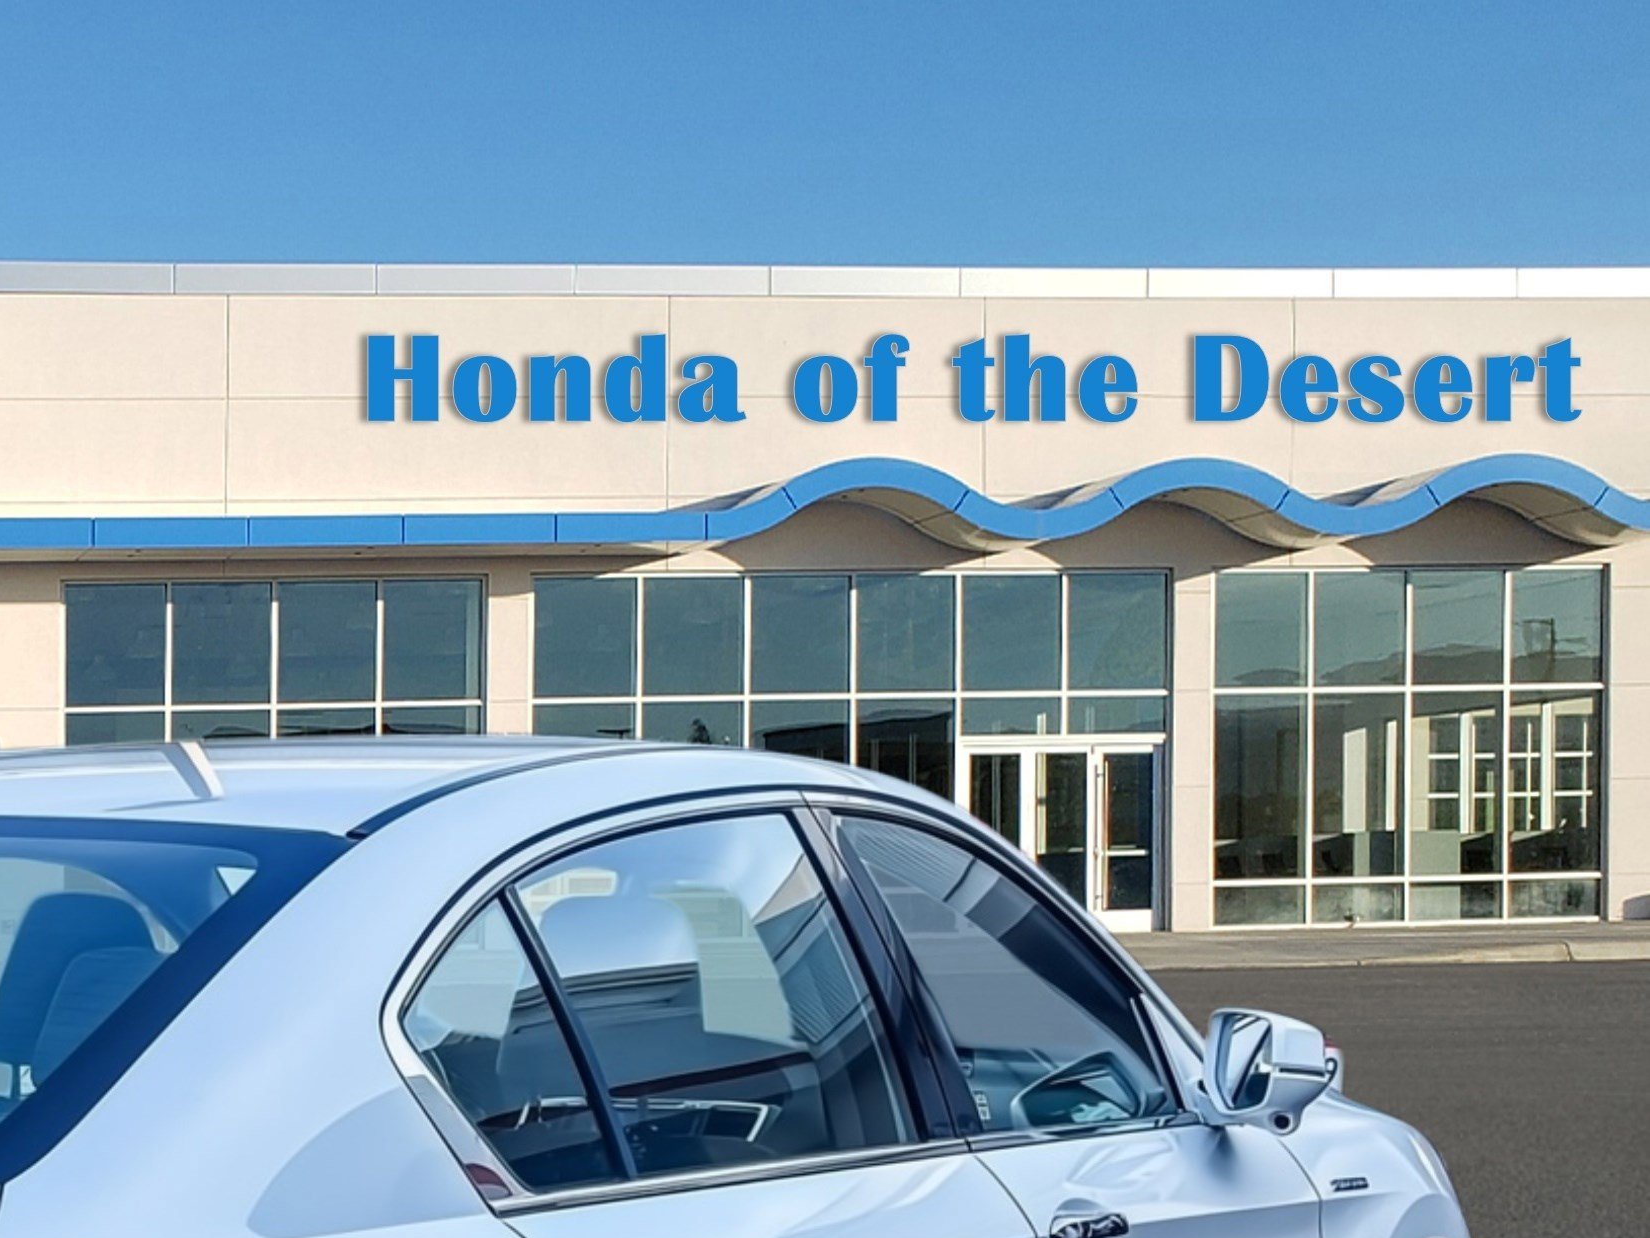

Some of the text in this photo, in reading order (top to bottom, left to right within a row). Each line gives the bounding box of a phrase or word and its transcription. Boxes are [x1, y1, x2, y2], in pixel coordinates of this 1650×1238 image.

[365, 333, 1583, 423] Honda of the Desert
